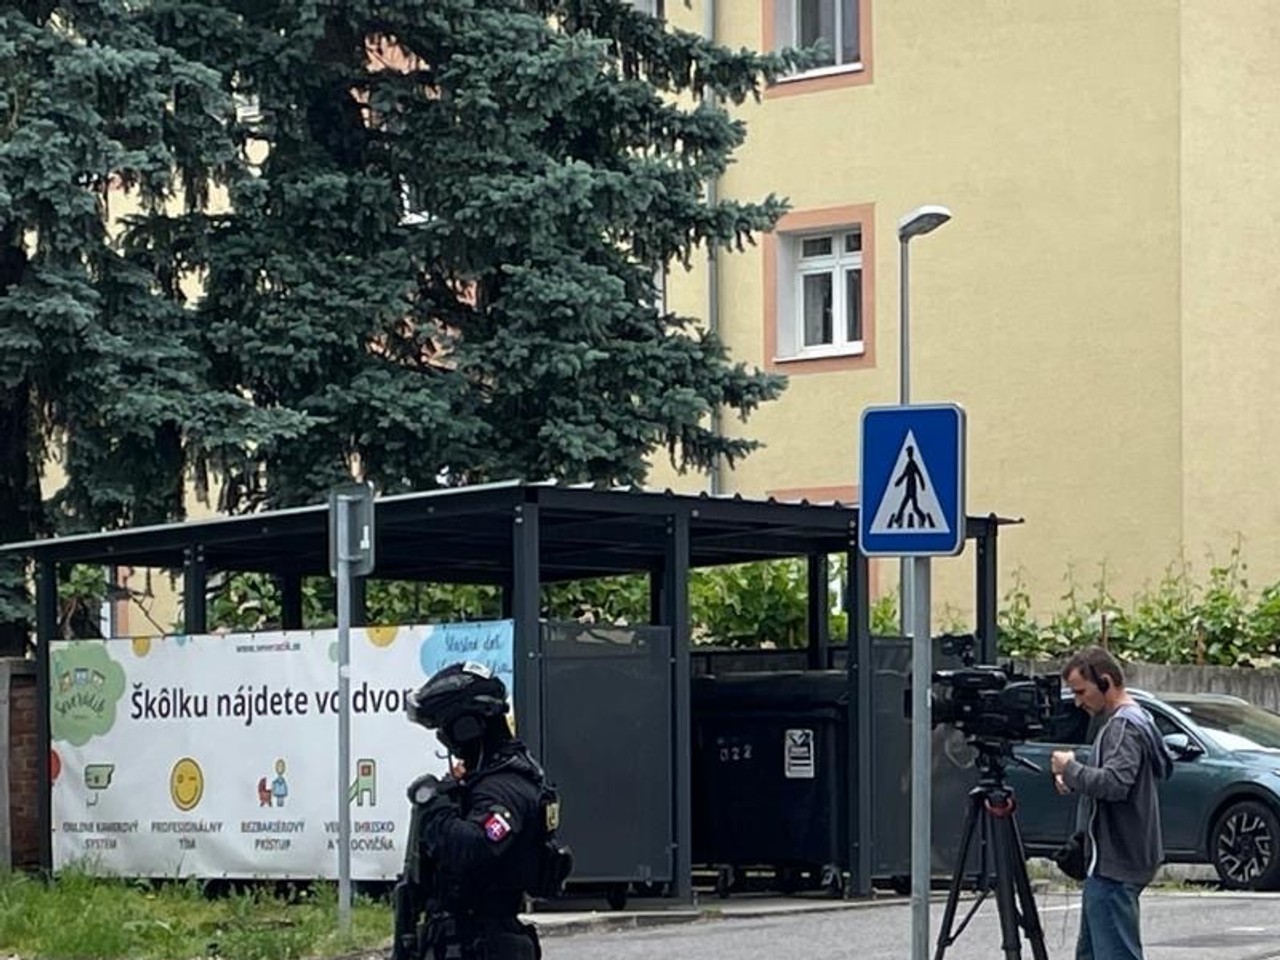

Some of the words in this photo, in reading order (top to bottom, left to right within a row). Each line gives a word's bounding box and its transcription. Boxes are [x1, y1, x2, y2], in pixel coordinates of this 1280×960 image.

[131, 684, 208, 720] Škôlku
[217, 685, 308, 726] nájdete
[352, 682, 412, 713] dvor
